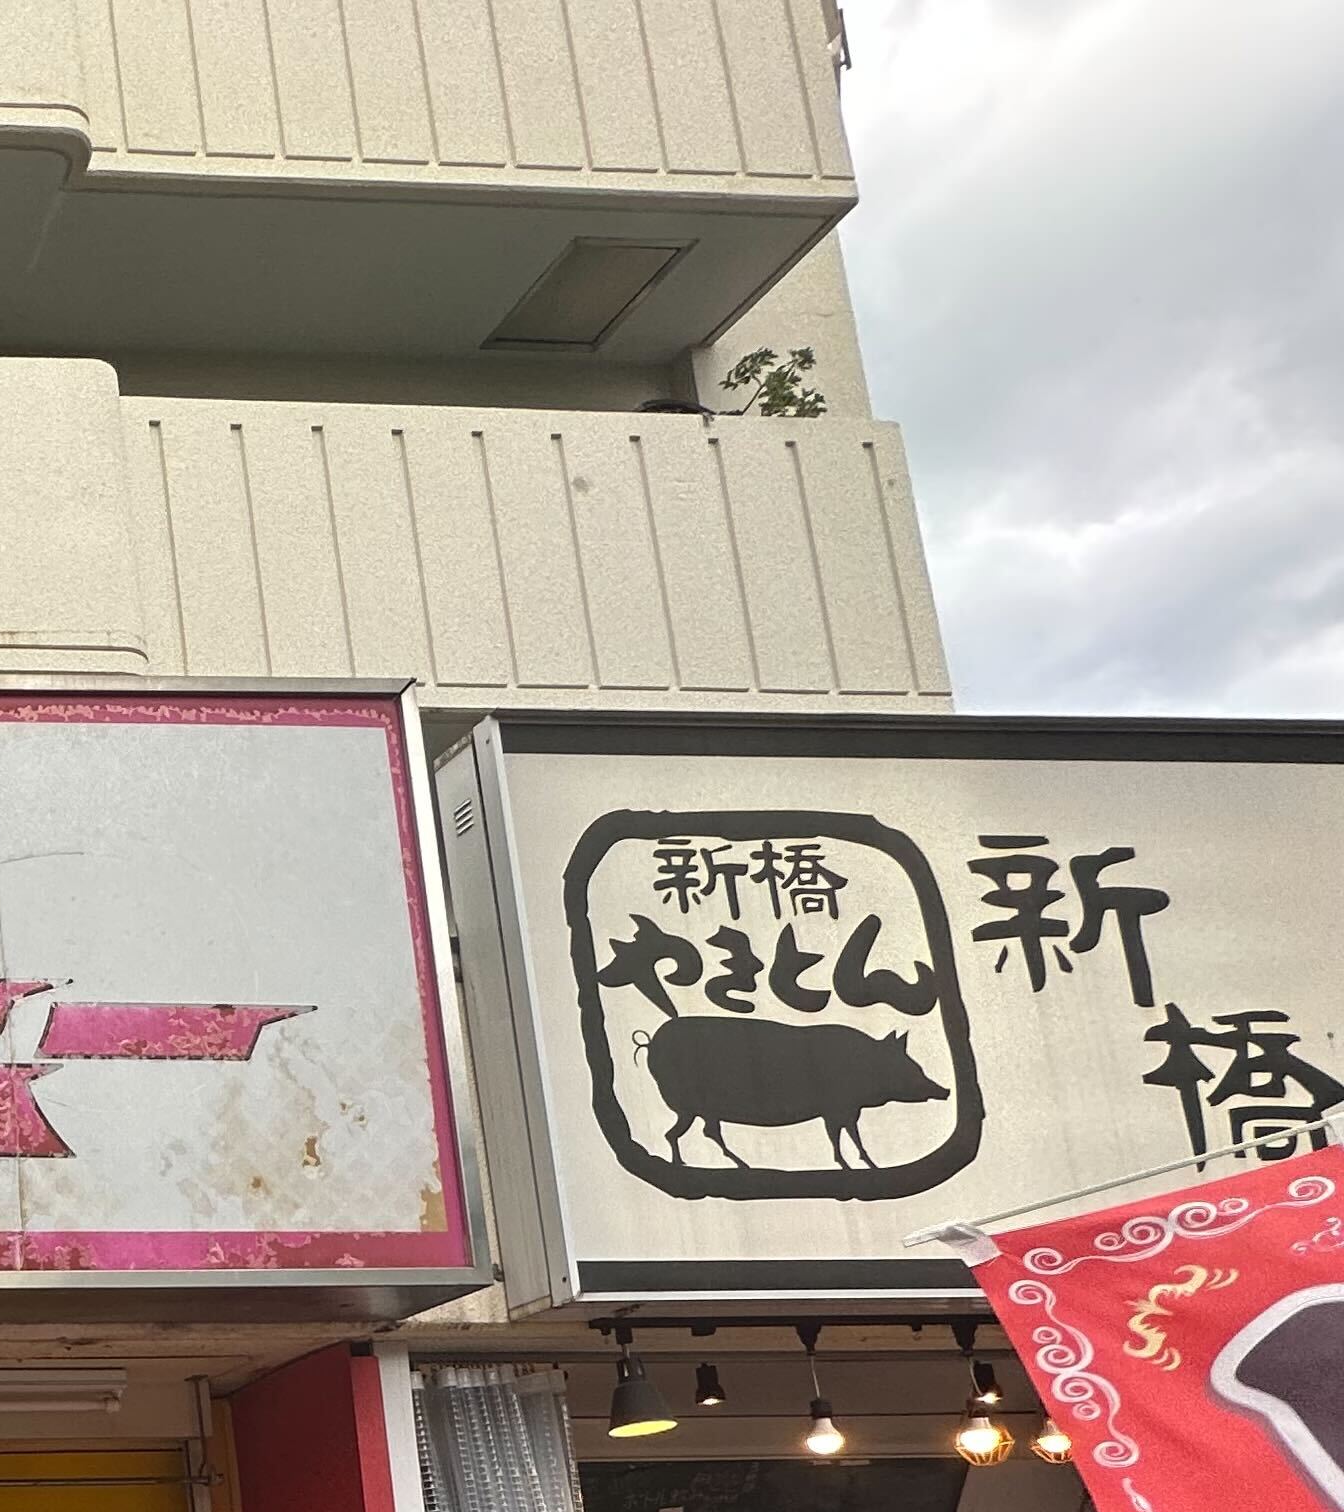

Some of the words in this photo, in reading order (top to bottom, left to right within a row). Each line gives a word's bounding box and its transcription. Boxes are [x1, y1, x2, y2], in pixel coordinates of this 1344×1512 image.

[652, 836, 848, 920] 新橋
[599, 914, 934, 1016] やきとん
